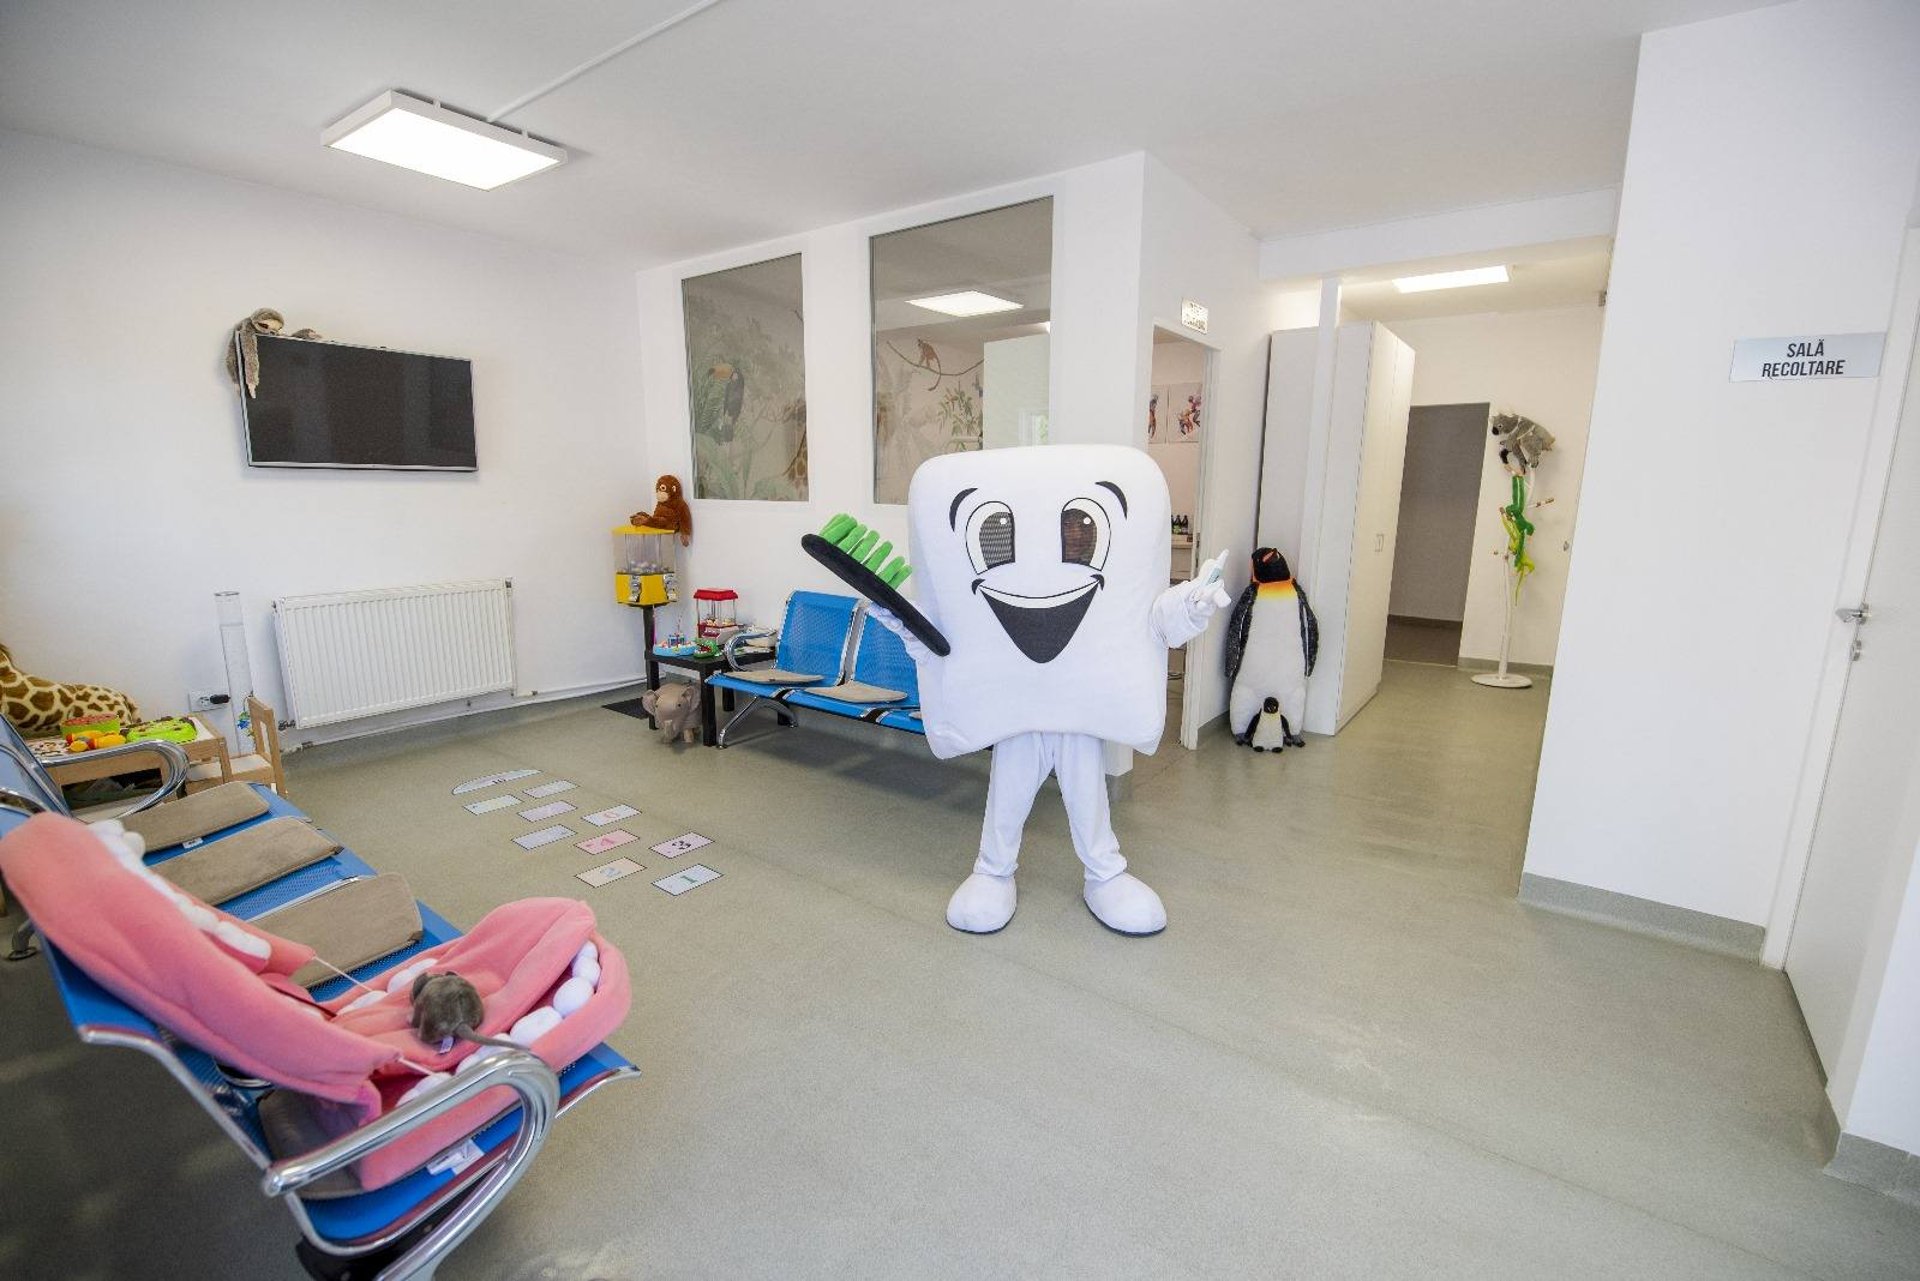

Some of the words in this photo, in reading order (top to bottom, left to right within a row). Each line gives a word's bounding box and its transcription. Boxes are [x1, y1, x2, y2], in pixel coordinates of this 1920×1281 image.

[1761, 360, 1845, 378] RECOLTARE
[671, 840, 691, 850] 3
[680, 875, 697, 884] 1
